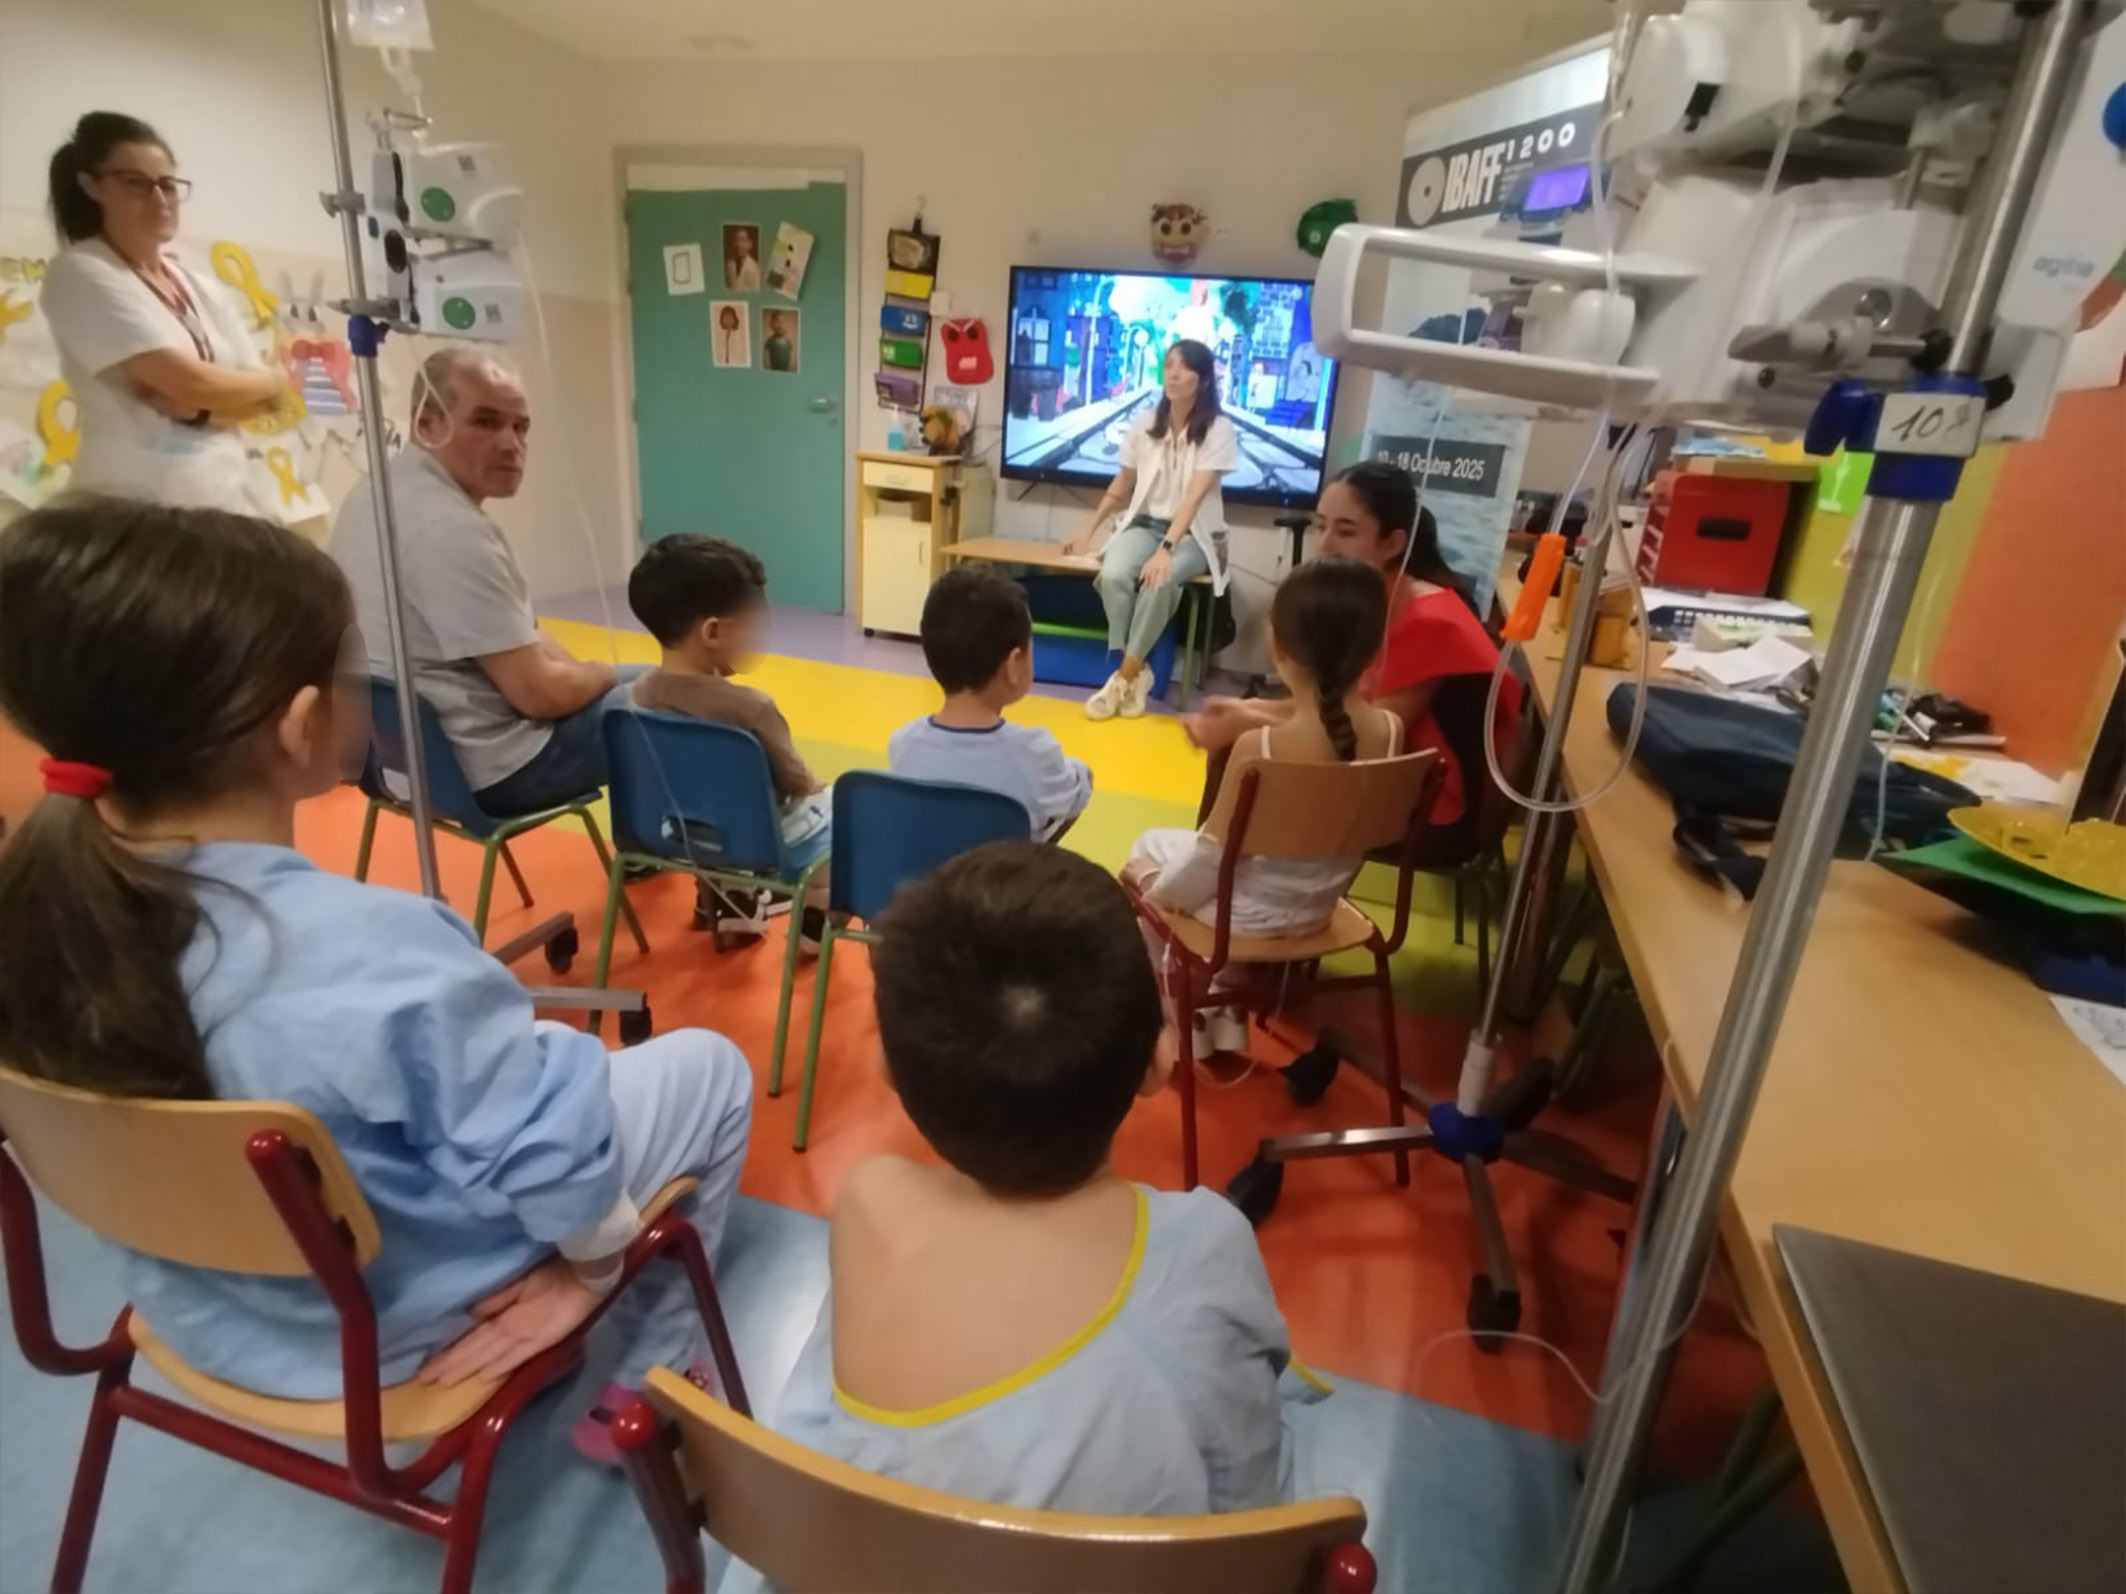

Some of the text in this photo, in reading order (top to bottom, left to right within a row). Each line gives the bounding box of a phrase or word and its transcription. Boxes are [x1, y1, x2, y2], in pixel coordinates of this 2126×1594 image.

[1506, 122, 1576, 162] 1200
[1397, 451, 1410, 471] 18
[1411, 453, 1451, 476] Ocubre
[1452, 457, 1486, 480] 2025
